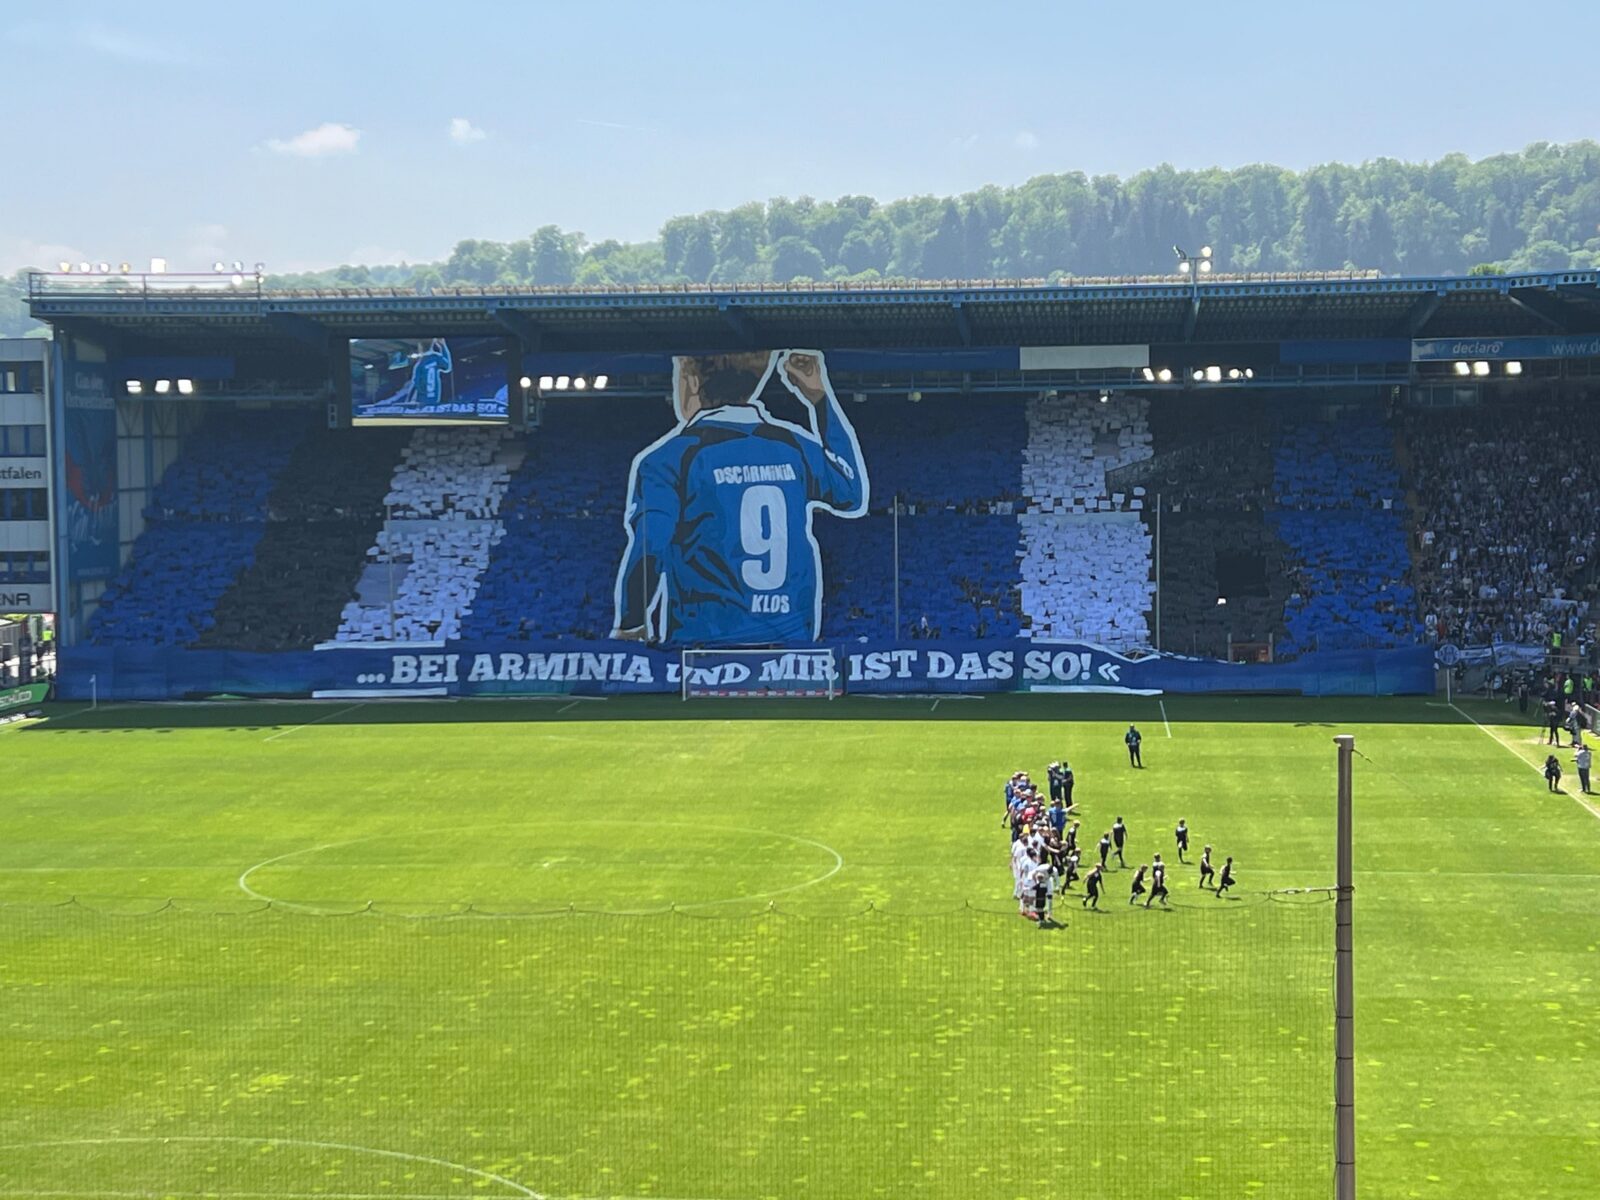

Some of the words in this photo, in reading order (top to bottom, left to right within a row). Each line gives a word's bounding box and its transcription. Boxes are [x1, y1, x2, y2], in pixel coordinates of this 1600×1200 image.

[1452, 341, 1501, 354] declaro
[1551, 338, 1600, 355] www.d
[0, 466, 42, 480] tfalen
[713, 466, 742, 484] DSC
[740, 485, 787, 590] 9
[0, 593, 31, 606] NA
[751, 594, 790, 613] KLOS
[467, 652, 654, 684] ARMINIA
[666, 662, 751, 685] UND
[758, 653, 839, 681] MIR
[848, 650, 918, 681] IST
[927, 651, 1013, 680] DAS
